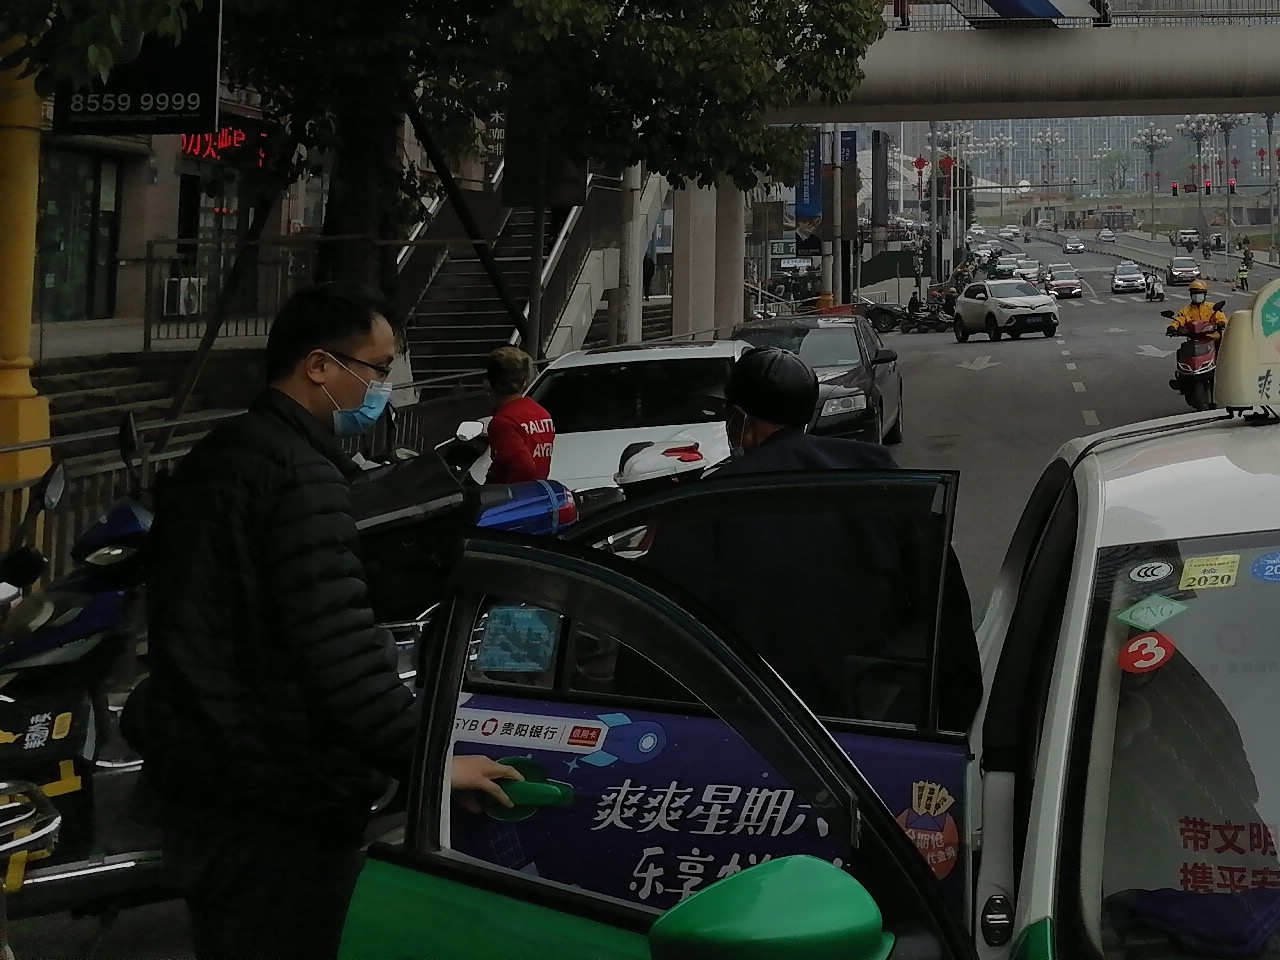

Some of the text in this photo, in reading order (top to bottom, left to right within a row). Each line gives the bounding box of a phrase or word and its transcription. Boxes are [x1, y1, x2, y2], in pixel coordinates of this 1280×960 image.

[70, 92, 201, 112] 8559 9999
[1185, 573, 1232, 588] 2020
[1129, 603, 1174, 622] CNG
[1128, 636, 1166, 668] 3
[500, 722, 558, 740] 贵阳银行
[572, 727, 598, 740] 信用卡
[590, 778, 829, 838] 爽爽星期六
